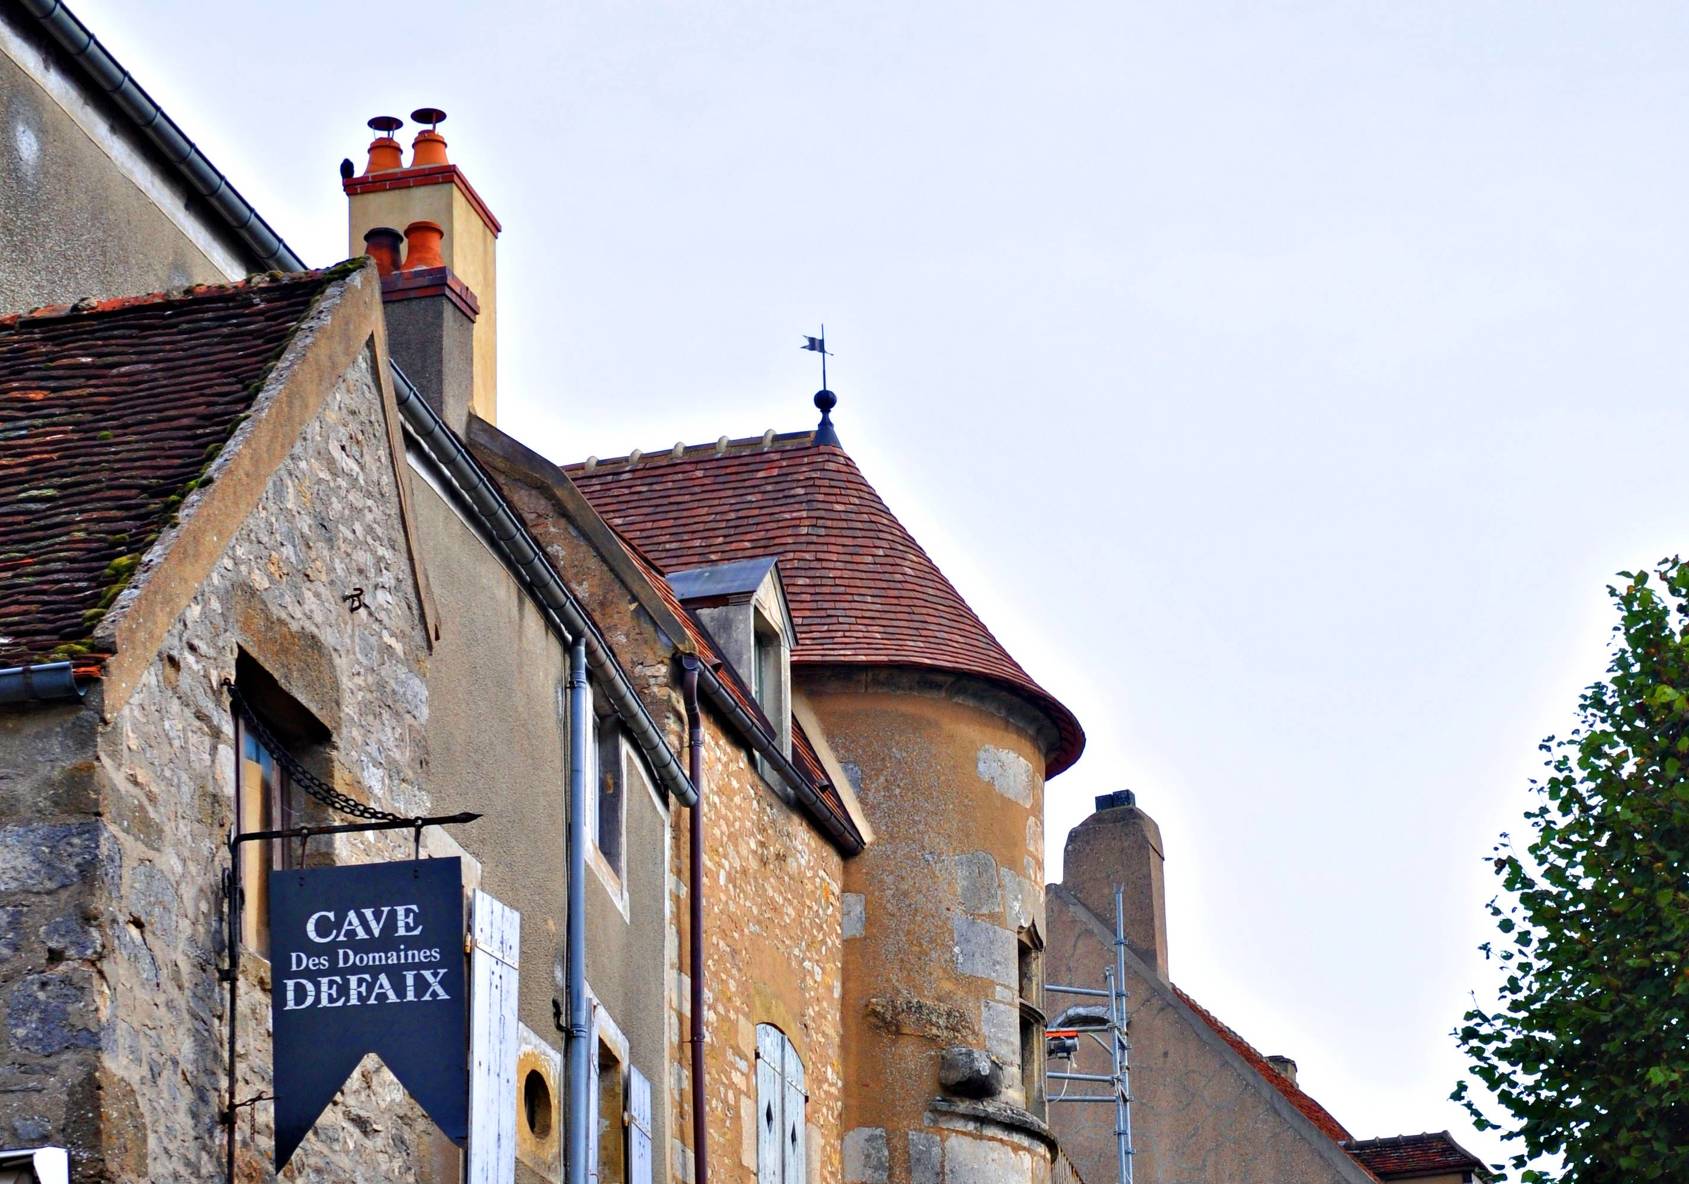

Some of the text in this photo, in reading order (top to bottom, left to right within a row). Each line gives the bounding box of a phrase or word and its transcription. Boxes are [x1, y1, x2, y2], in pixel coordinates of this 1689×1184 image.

[306, 904, 423, 944] CAVE
[290, 944, 441, 971] Des Domaines
[282, 968, 451, 1011] DEFAIX
